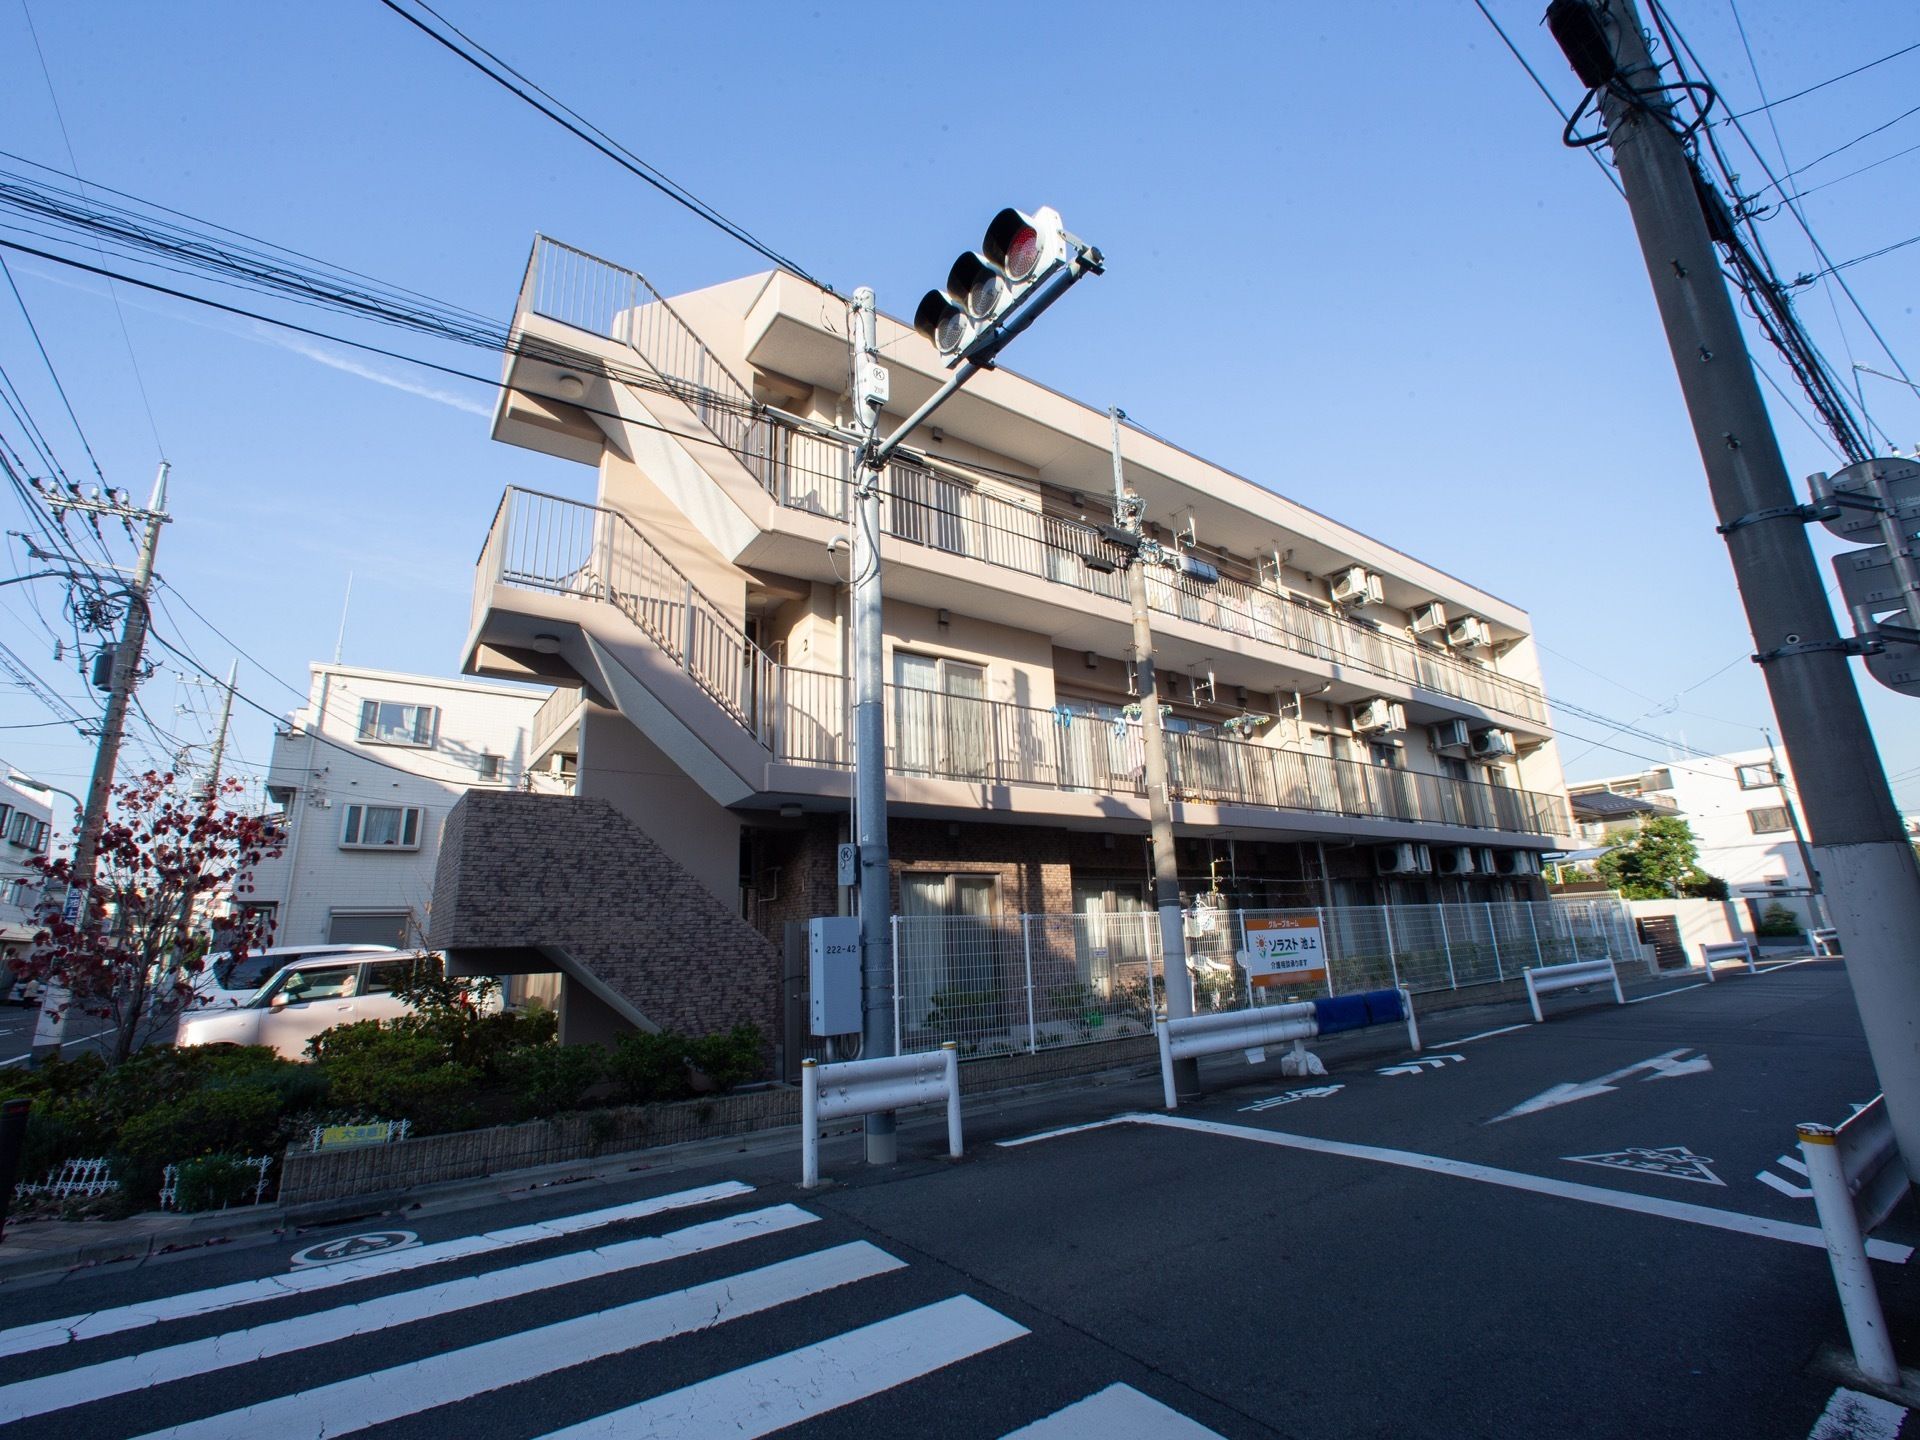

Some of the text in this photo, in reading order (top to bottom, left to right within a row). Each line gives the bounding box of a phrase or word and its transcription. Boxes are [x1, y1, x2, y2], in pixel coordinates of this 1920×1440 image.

[1268, 919, 1299, 929] グループホーム
[826, 944, 857, 954] 222-42
[1268, 936, 1316, 952] ソラスト 池上
